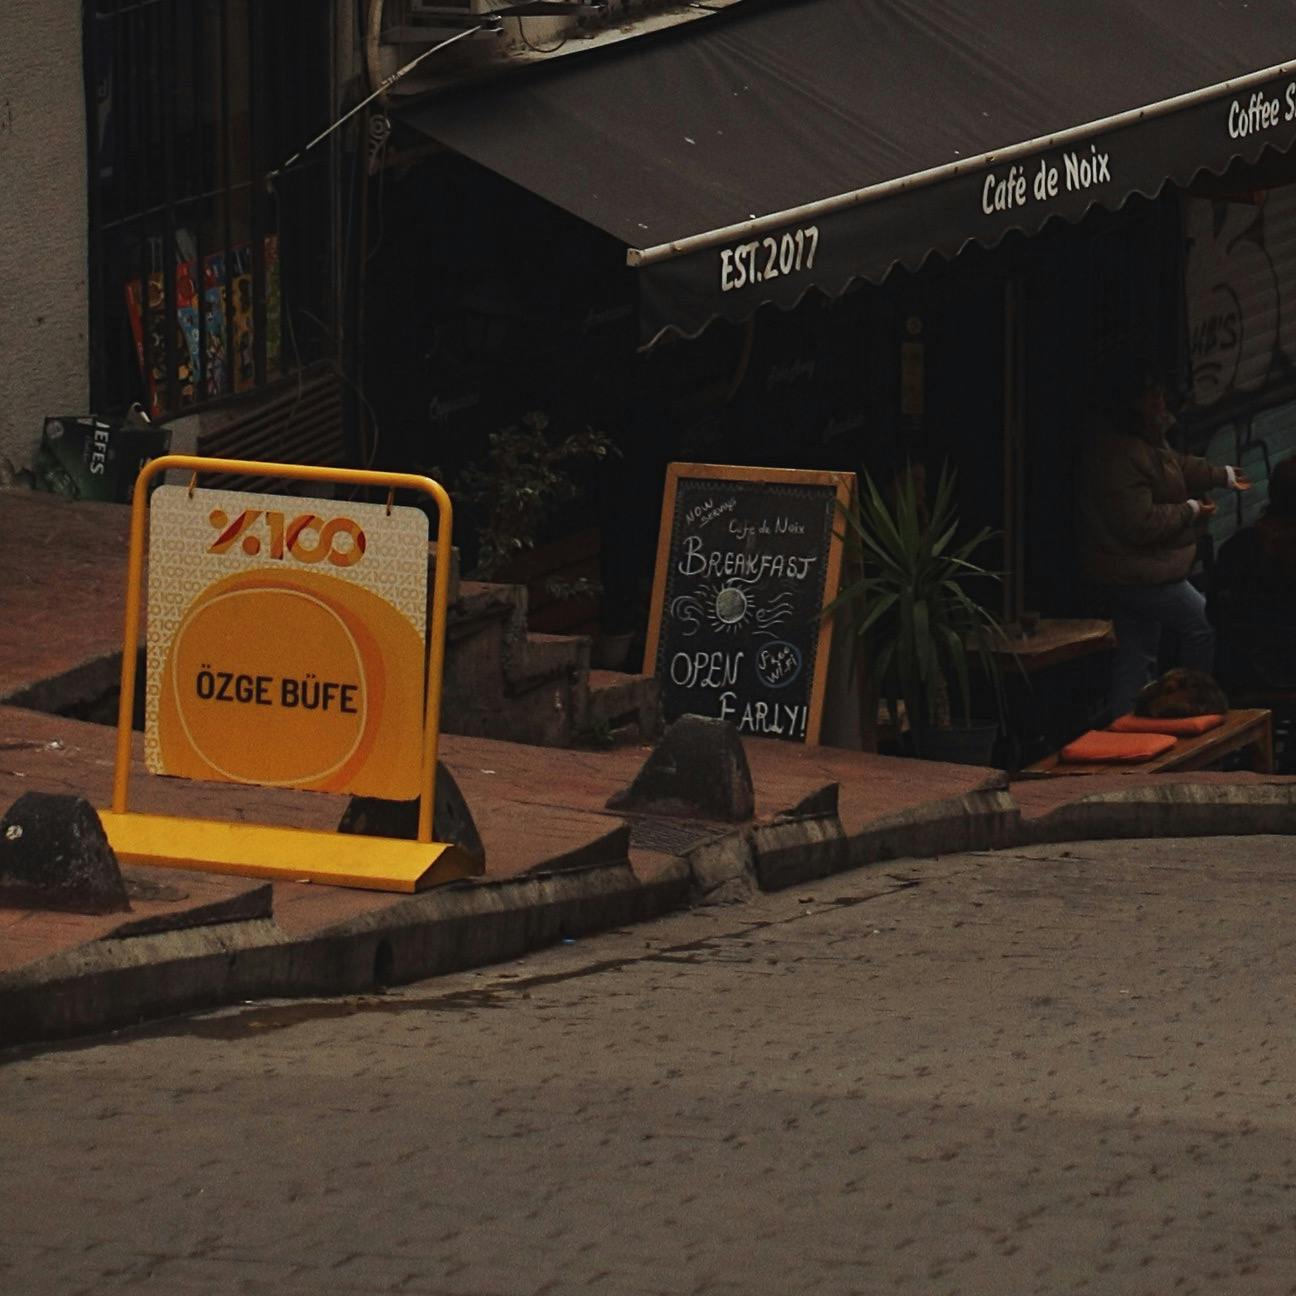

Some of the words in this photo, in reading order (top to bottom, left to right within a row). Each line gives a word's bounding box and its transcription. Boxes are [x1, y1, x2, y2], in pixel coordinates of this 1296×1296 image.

[1228, 91, 1279, 139] Coffee
[982, 165, 1027, 215] Café
[1034, 164, 1059, 200] de
[1065, 145, 1111, 190] Noix
[720, 225, 819, 292] EST.2017
[90, 430, 110, 475] EFES
[678, 535, 817, 583] BREAKFAST
[196, 664, 273, 706] ÖZGE
[281, 673, 358, 714] BÜFE
[670, 651, 744, 688] OPEN
